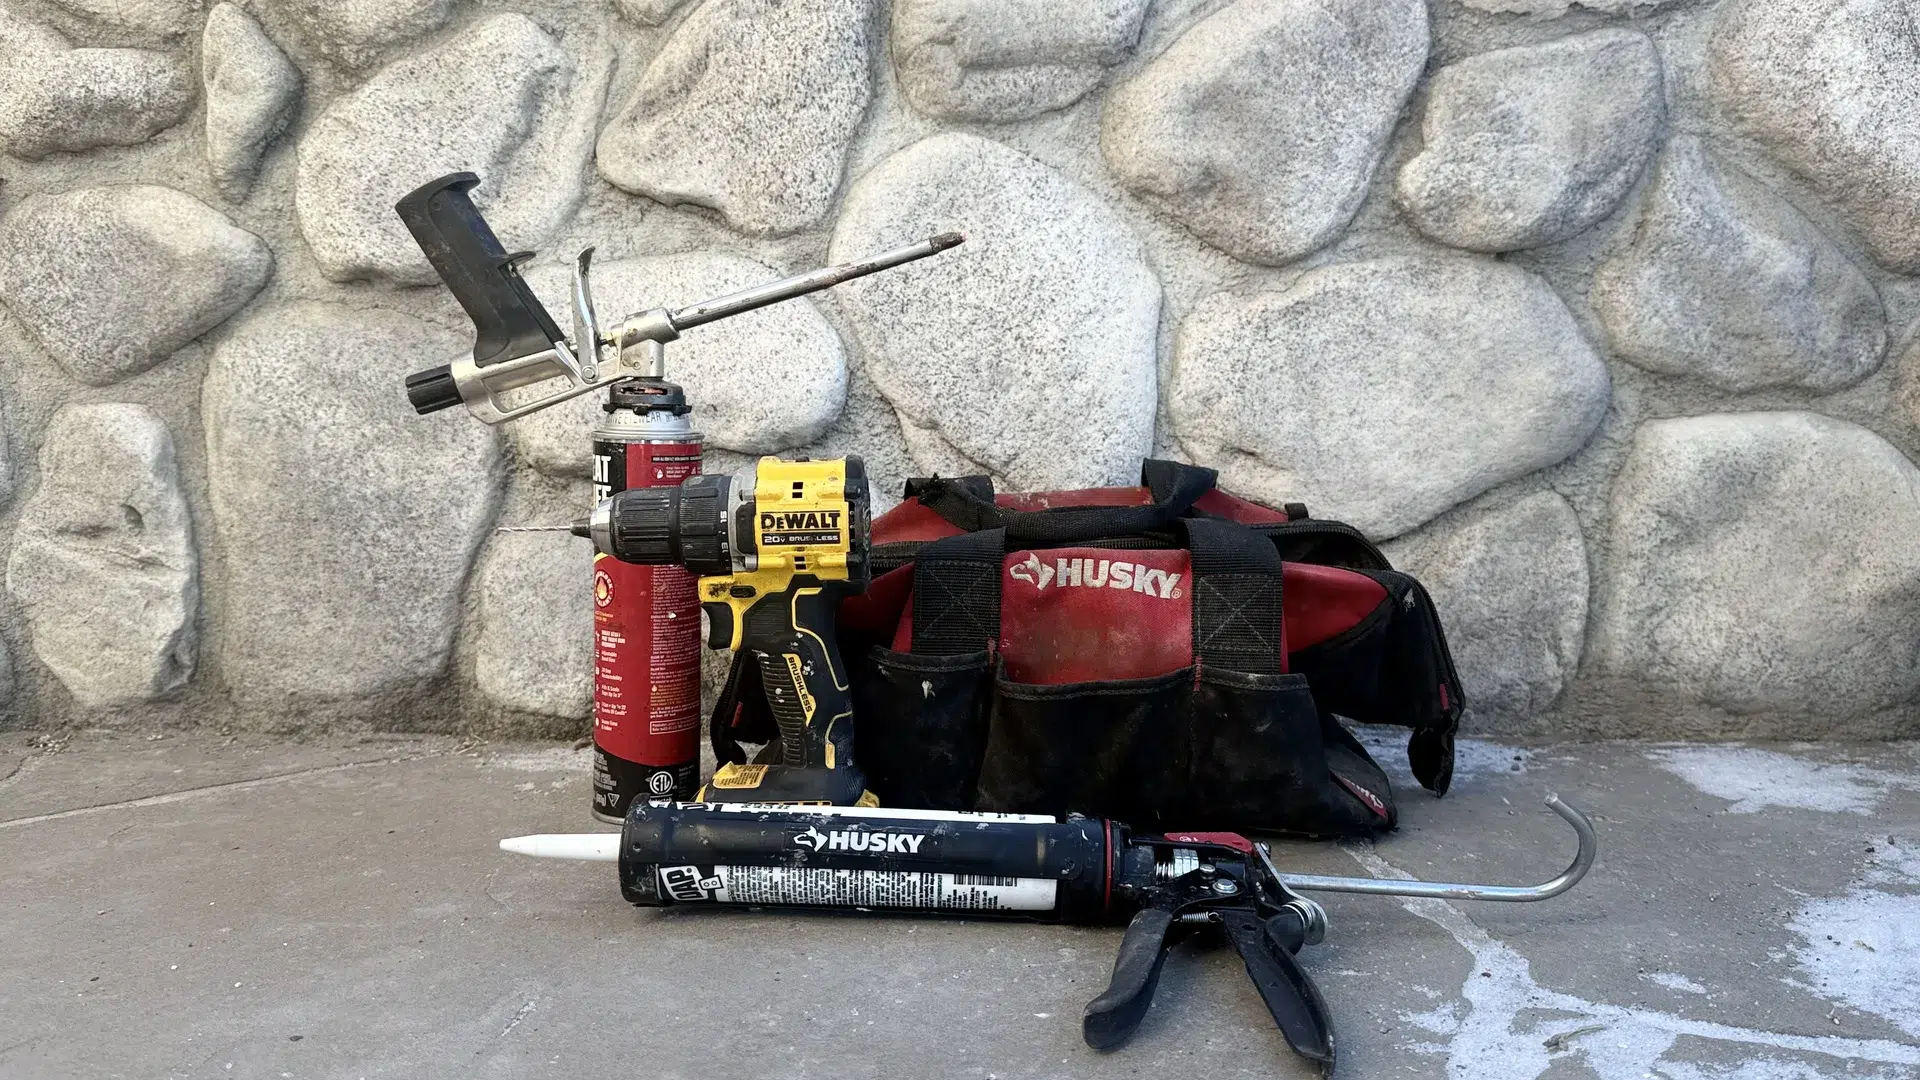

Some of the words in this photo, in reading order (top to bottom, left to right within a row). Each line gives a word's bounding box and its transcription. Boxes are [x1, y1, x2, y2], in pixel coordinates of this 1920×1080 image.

[720, 510, 727, 523] 15
[760, 512, 841, 529] DEWALT
[1056, 557, 1182, 599] HUSKY
[788, 656, 813, 713] BRUSHLESS
[653, 774, 671, 792] ETL
[828, 831, 925, 854] HUSKY
[666, 869, 704, 899] DAP
